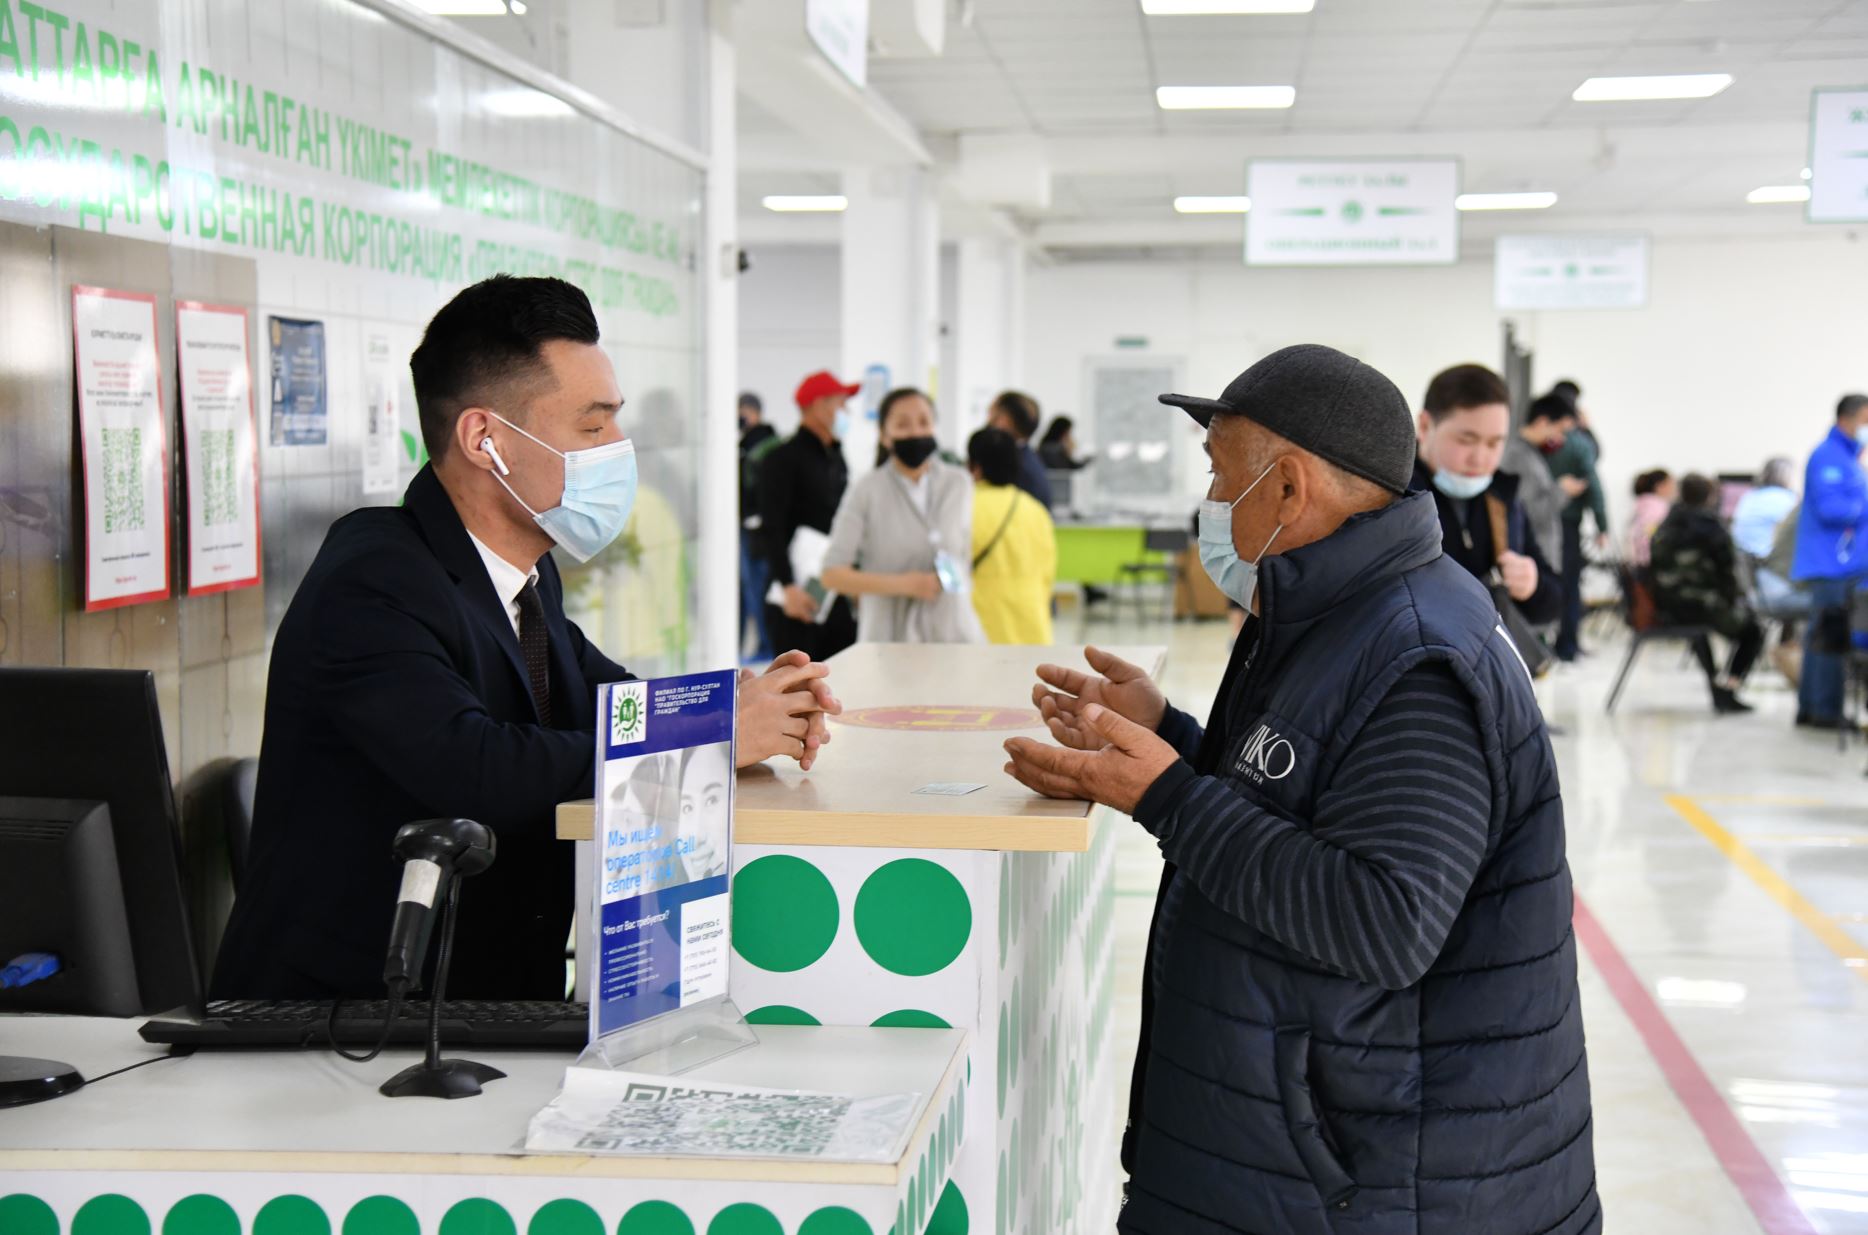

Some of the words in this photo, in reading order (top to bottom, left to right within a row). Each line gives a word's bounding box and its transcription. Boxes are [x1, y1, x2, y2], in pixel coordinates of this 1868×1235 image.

[176, 61, 331, 171] АРНАЛҒАН
[322, 201, 462, 292] КОРПОРАЦИЯ
[608, 830, 627, 848] Мы
[675, 834, 696, 857] Call
[606, 874, 641, 895] centre
[603, 926, 616, 936] Что
[616, 924, 624, 933] от
[624, 920, 636, 931] Вас
